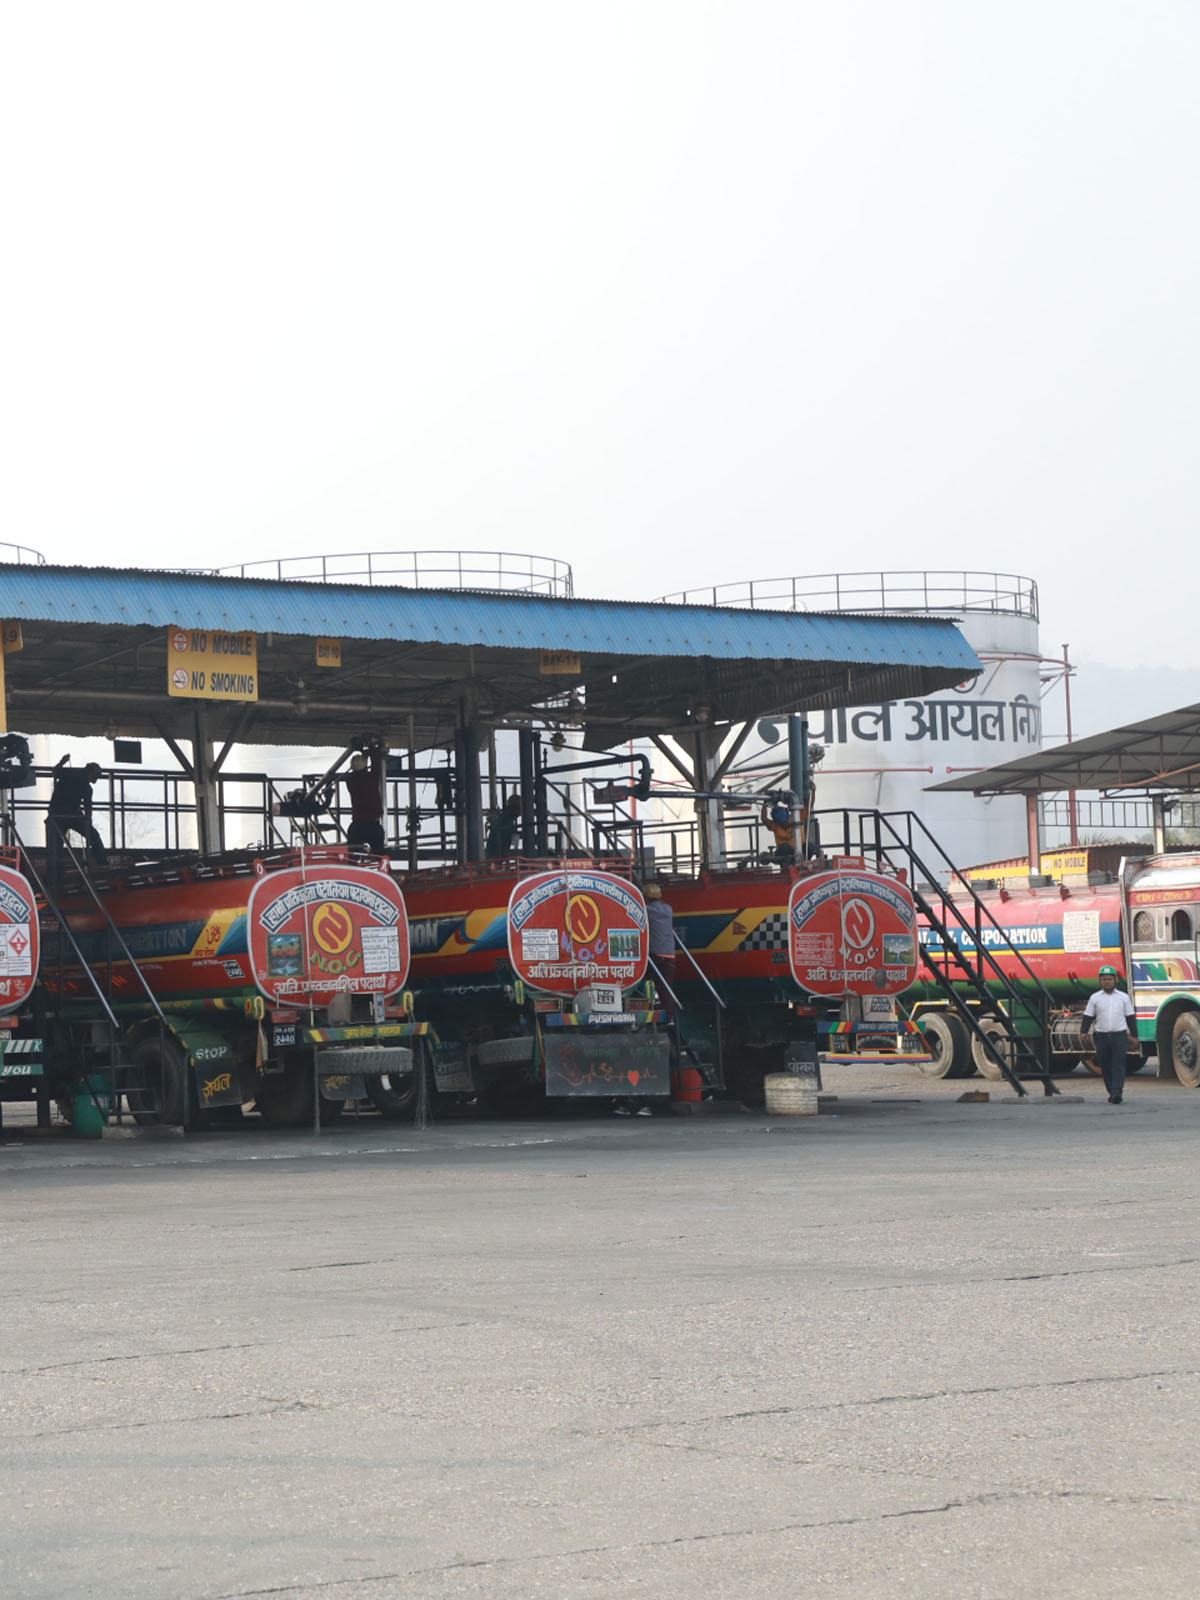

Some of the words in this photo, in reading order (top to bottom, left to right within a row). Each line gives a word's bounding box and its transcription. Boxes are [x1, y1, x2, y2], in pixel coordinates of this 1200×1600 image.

[190, 632, 206, 653] NO
[213, 633, 252, 656] MOBILE
[191, 671, 205, 690] NO
[211, 672, 254, 694] SMOKING
[904, 700, 1006, 742] आयल
